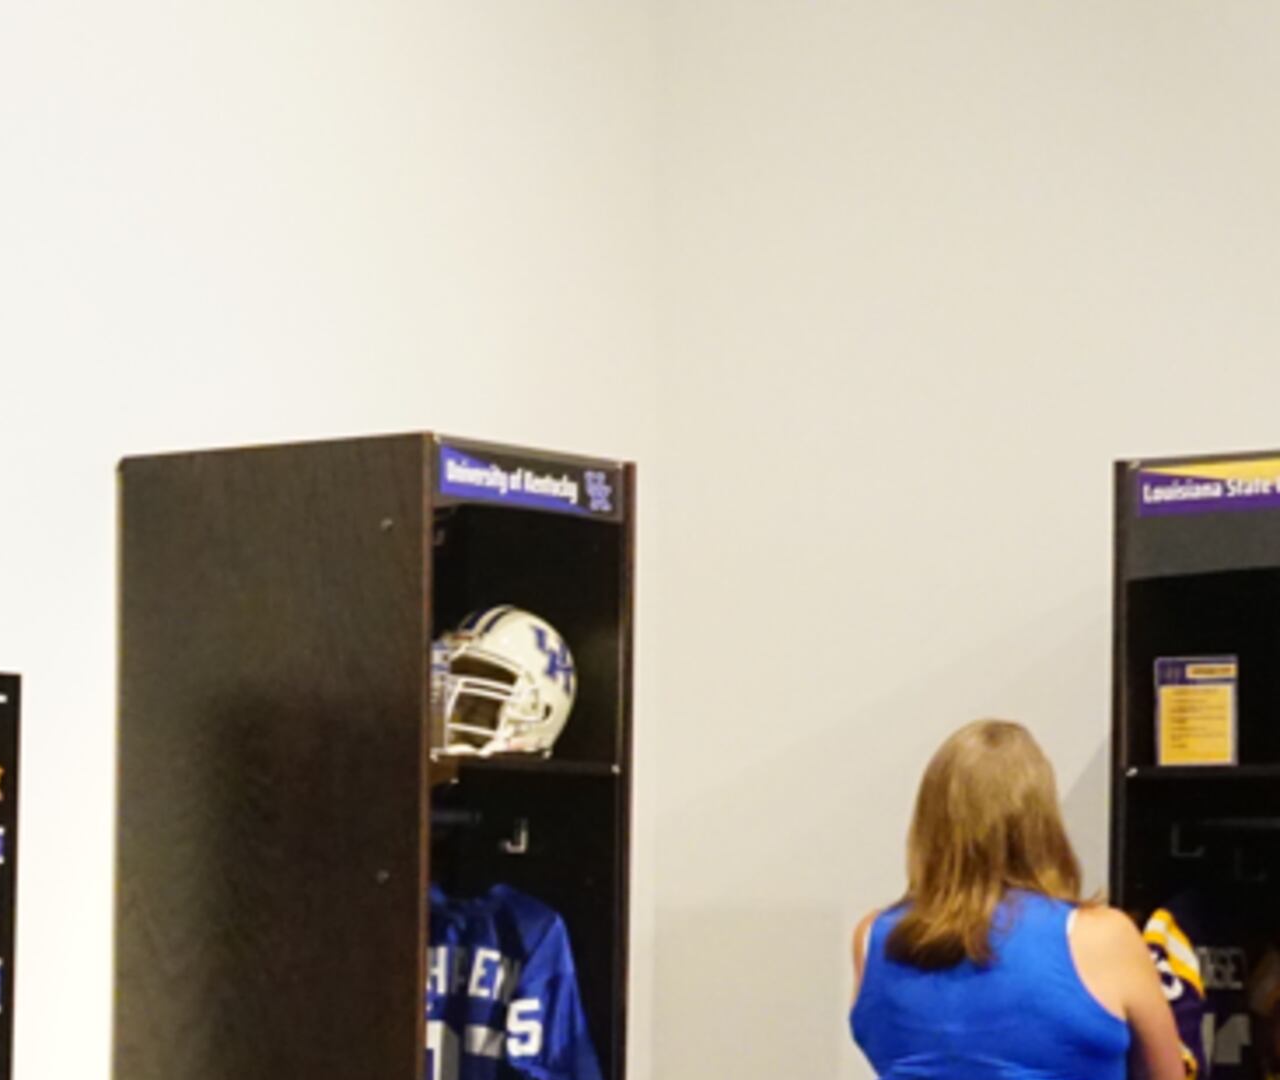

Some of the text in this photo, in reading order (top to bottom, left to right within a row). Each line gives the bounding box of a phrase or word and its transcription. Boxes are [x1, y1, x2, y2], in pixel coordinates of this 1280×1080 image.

[446, 459, 578, 504] University of Kentucky
[1143, 478, 1222, 504] Louisiana
[1227, 477, 1271, 497] State
